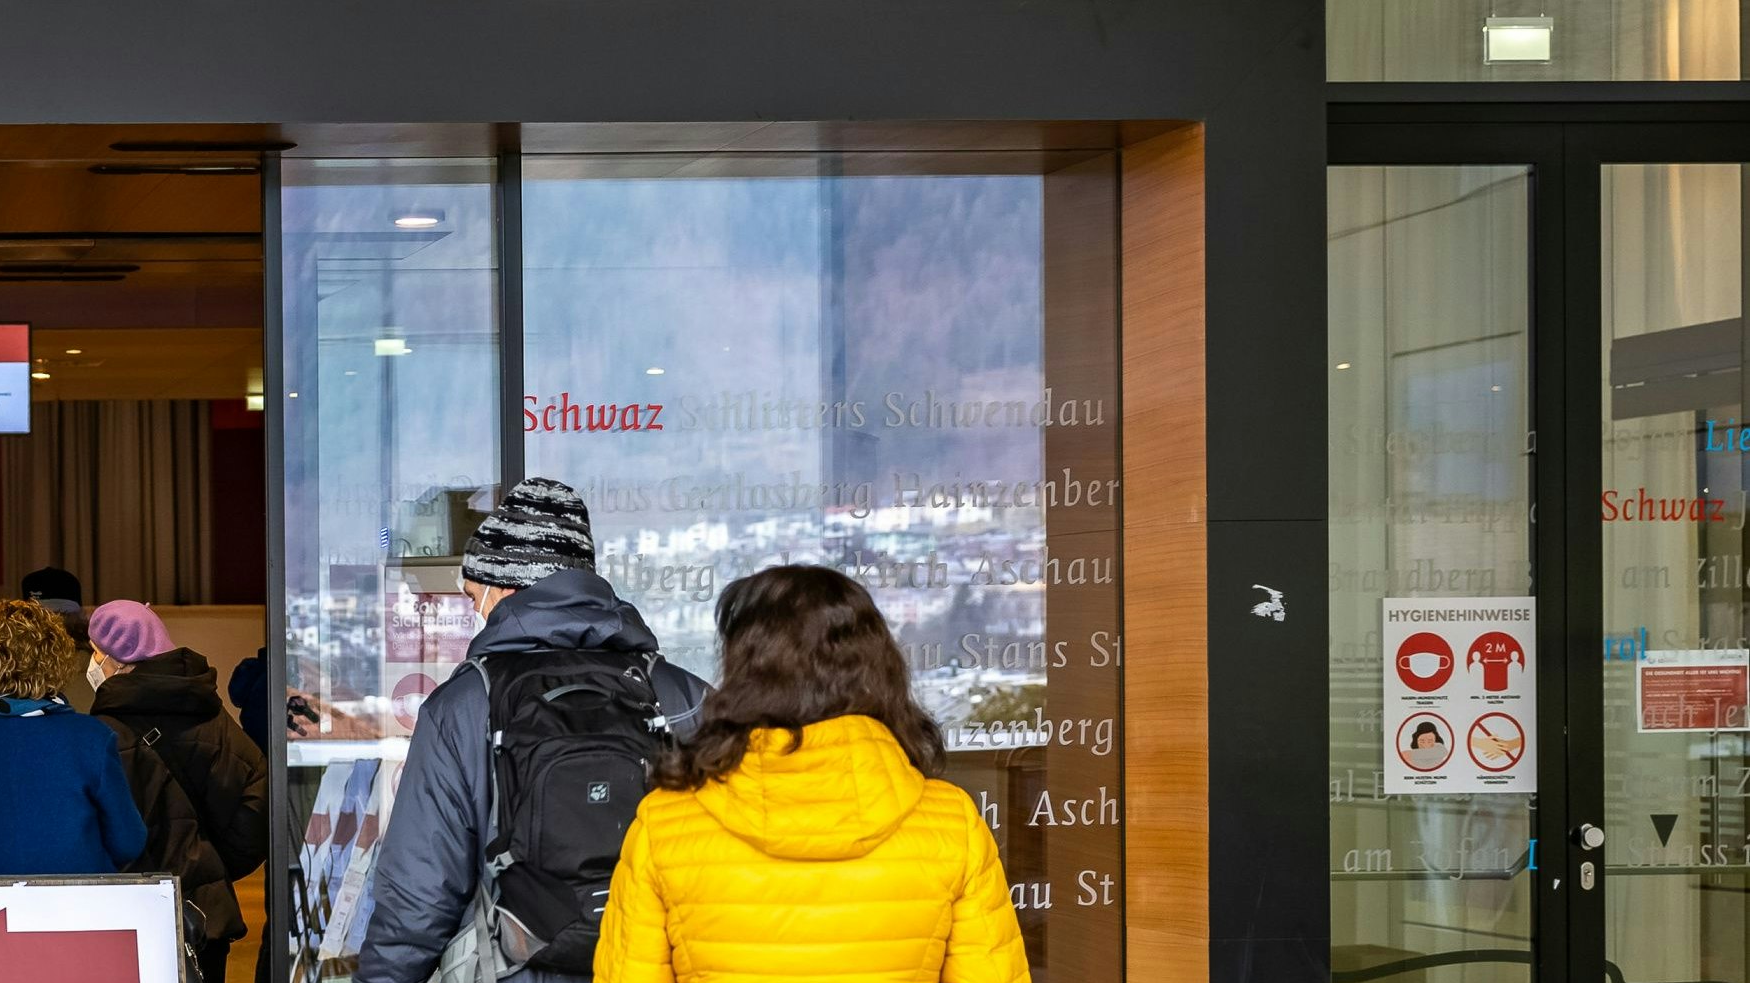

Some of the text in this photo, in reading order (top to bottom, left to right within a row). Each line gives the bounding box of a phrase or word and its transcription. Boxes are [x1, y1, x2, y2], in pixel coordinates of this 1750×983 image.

[523, 393, 664, 432] Schwaz
[884, 387, 1106, 430] Schwendau
[659, 469, 875, 518] Gerlosberg
[1601, 487, 1725, 522] Schwaz
[970, 546, 1114, 587] Aschau
[1388, 608, 1530, 622] HYGIENEHINWEISE
[961, 632, 1069, 669] Stans
[1485, 643, 1506, 653] 2 M
[1027, 785, 1119, 827] Asch
[1343, 848, 1393, 873] am
[1078, 869, 1115, 907] St
